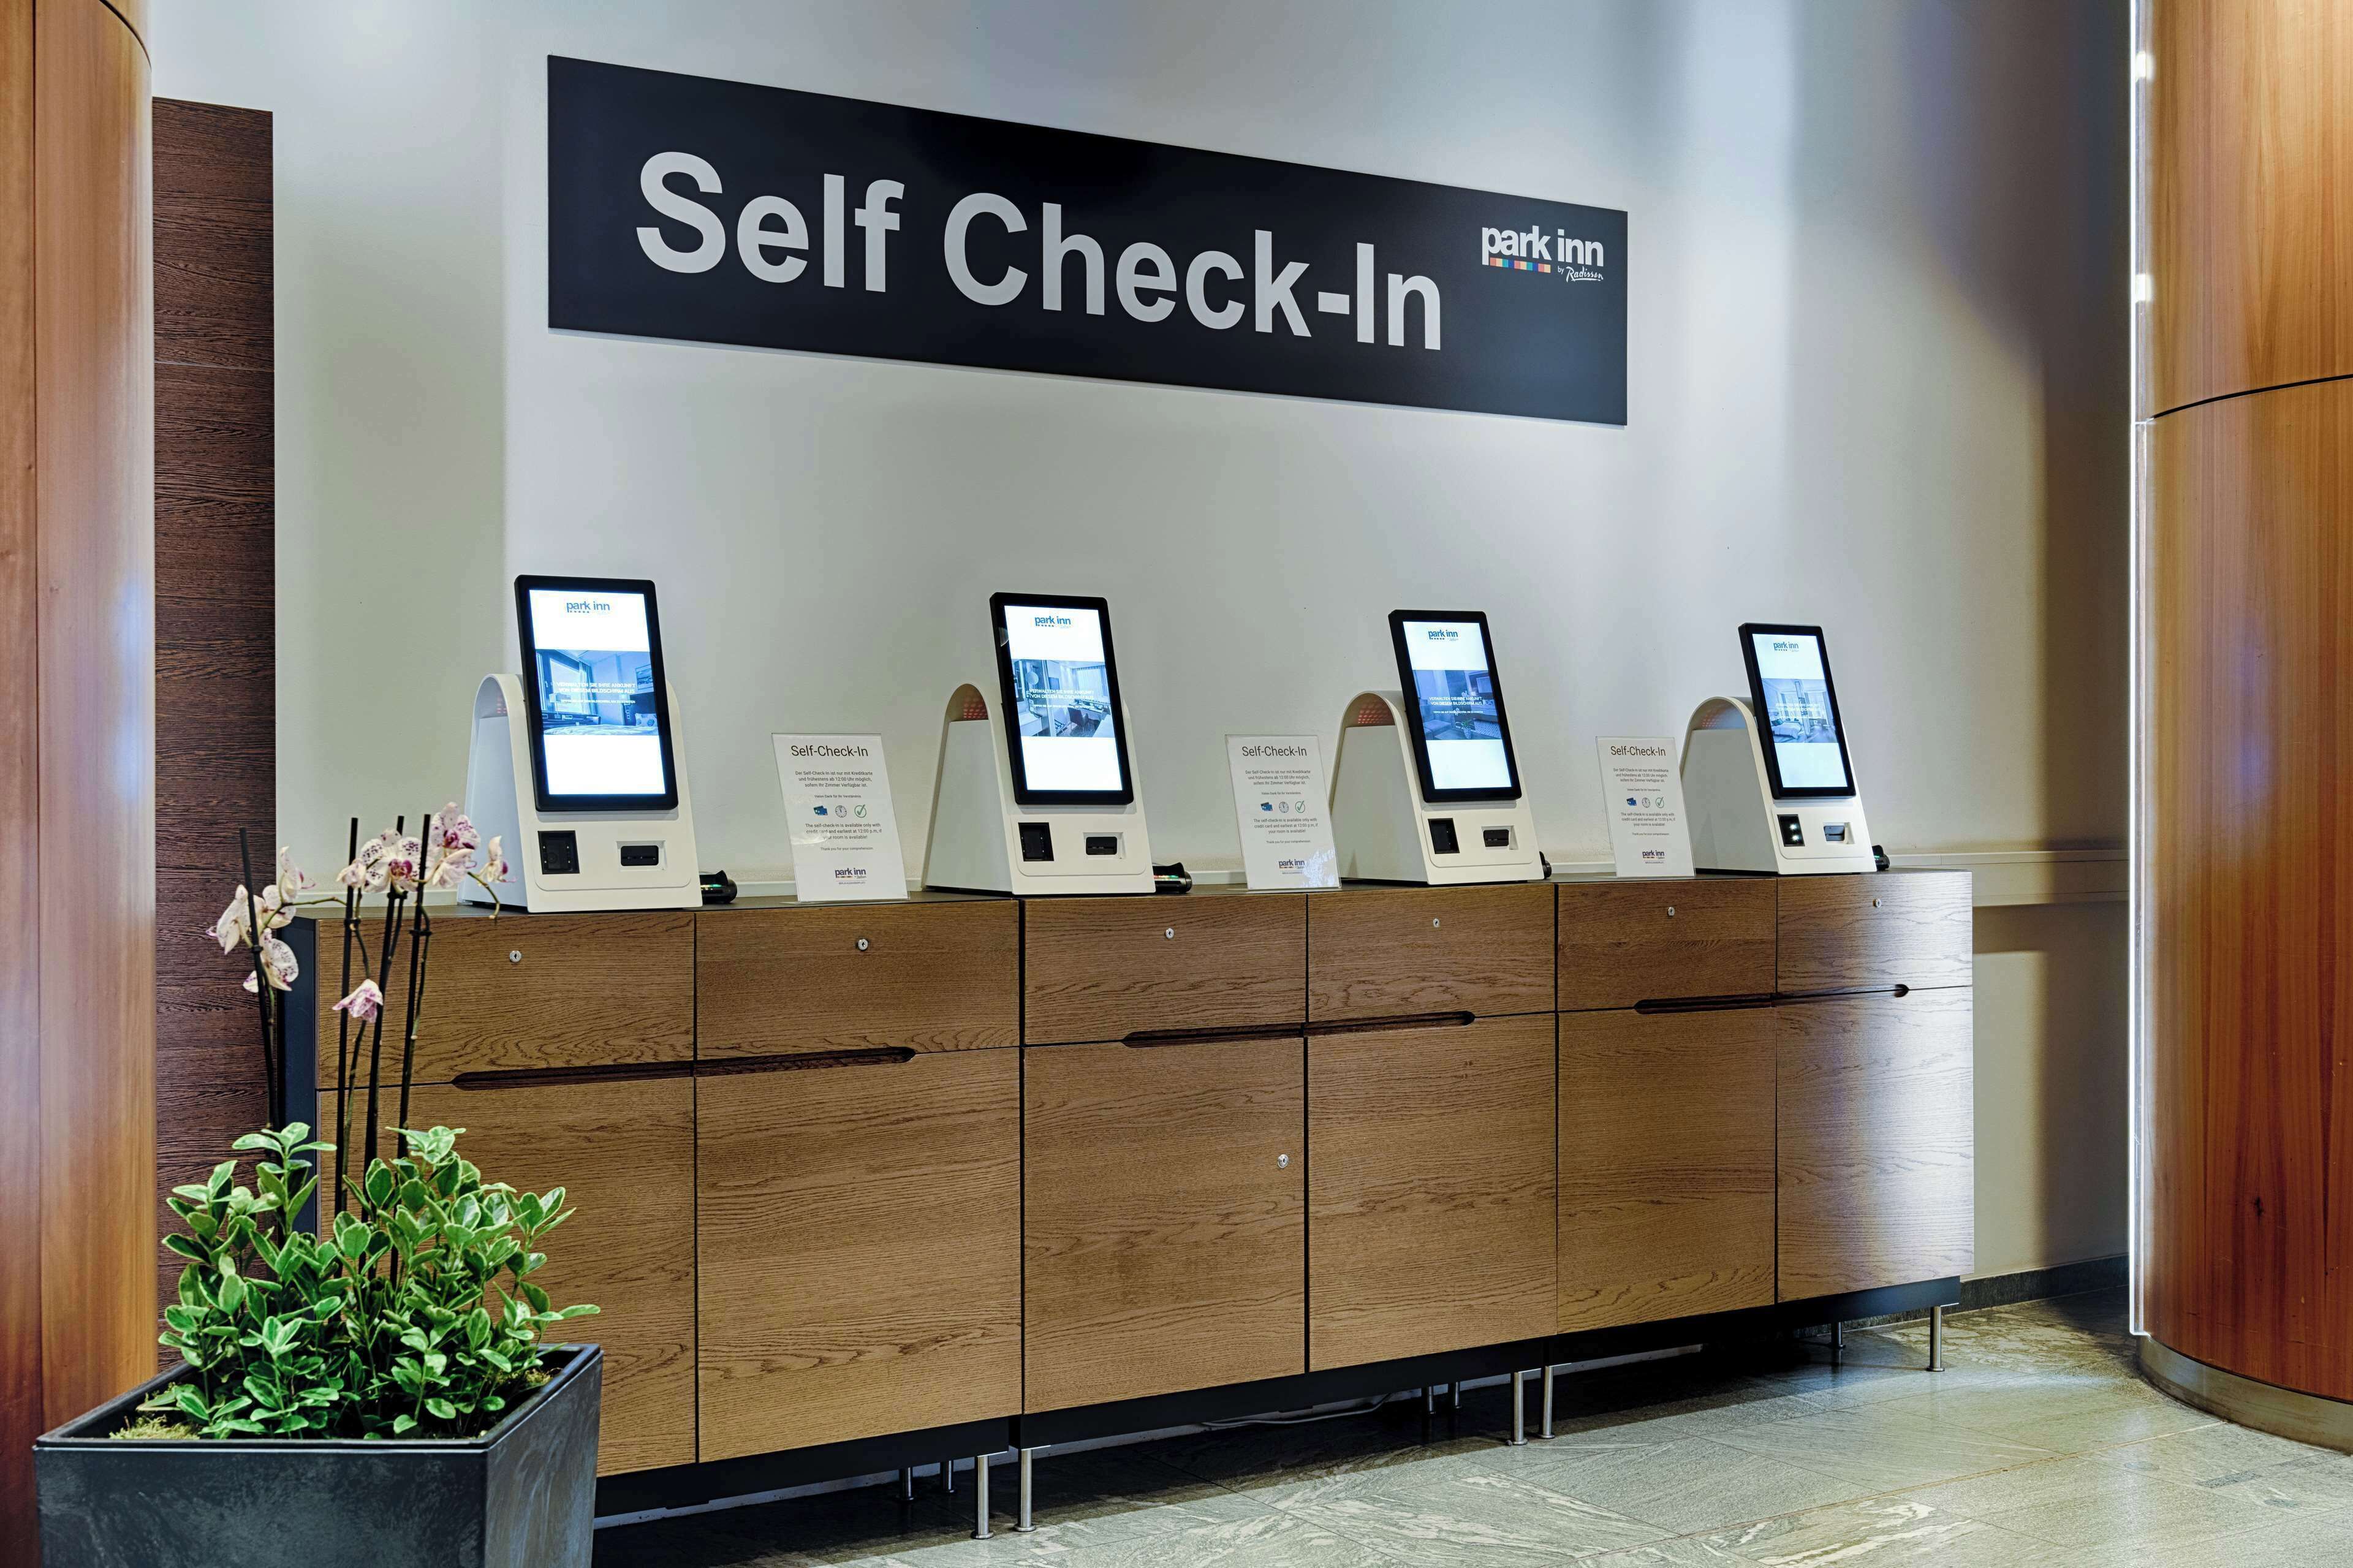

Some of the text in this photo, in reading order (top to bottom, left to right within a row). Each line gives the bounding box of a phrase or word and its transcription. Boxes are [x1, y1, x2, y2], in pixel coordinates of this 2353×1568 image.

[636, 151, 1441, 350] Self Check-In
[1482, 225, 1603, 267] park inn
[1566, 266, 1603, 282] Radisson
[566, 600, 610, 613] park inn
[1034, 615, 1070, 626] park inn
[1428, 629, 1446, 639] park
[1773, 642, 1787, 651] park
[790, 745, 868, 756] Self-Check-In
[1242, 746, 1307, 756] Self-Check-In
[1611, 746, 1665, 756] Self-Check-In
[1279, 859, 1294, 868] park
[835, 868, 852, 877] park
